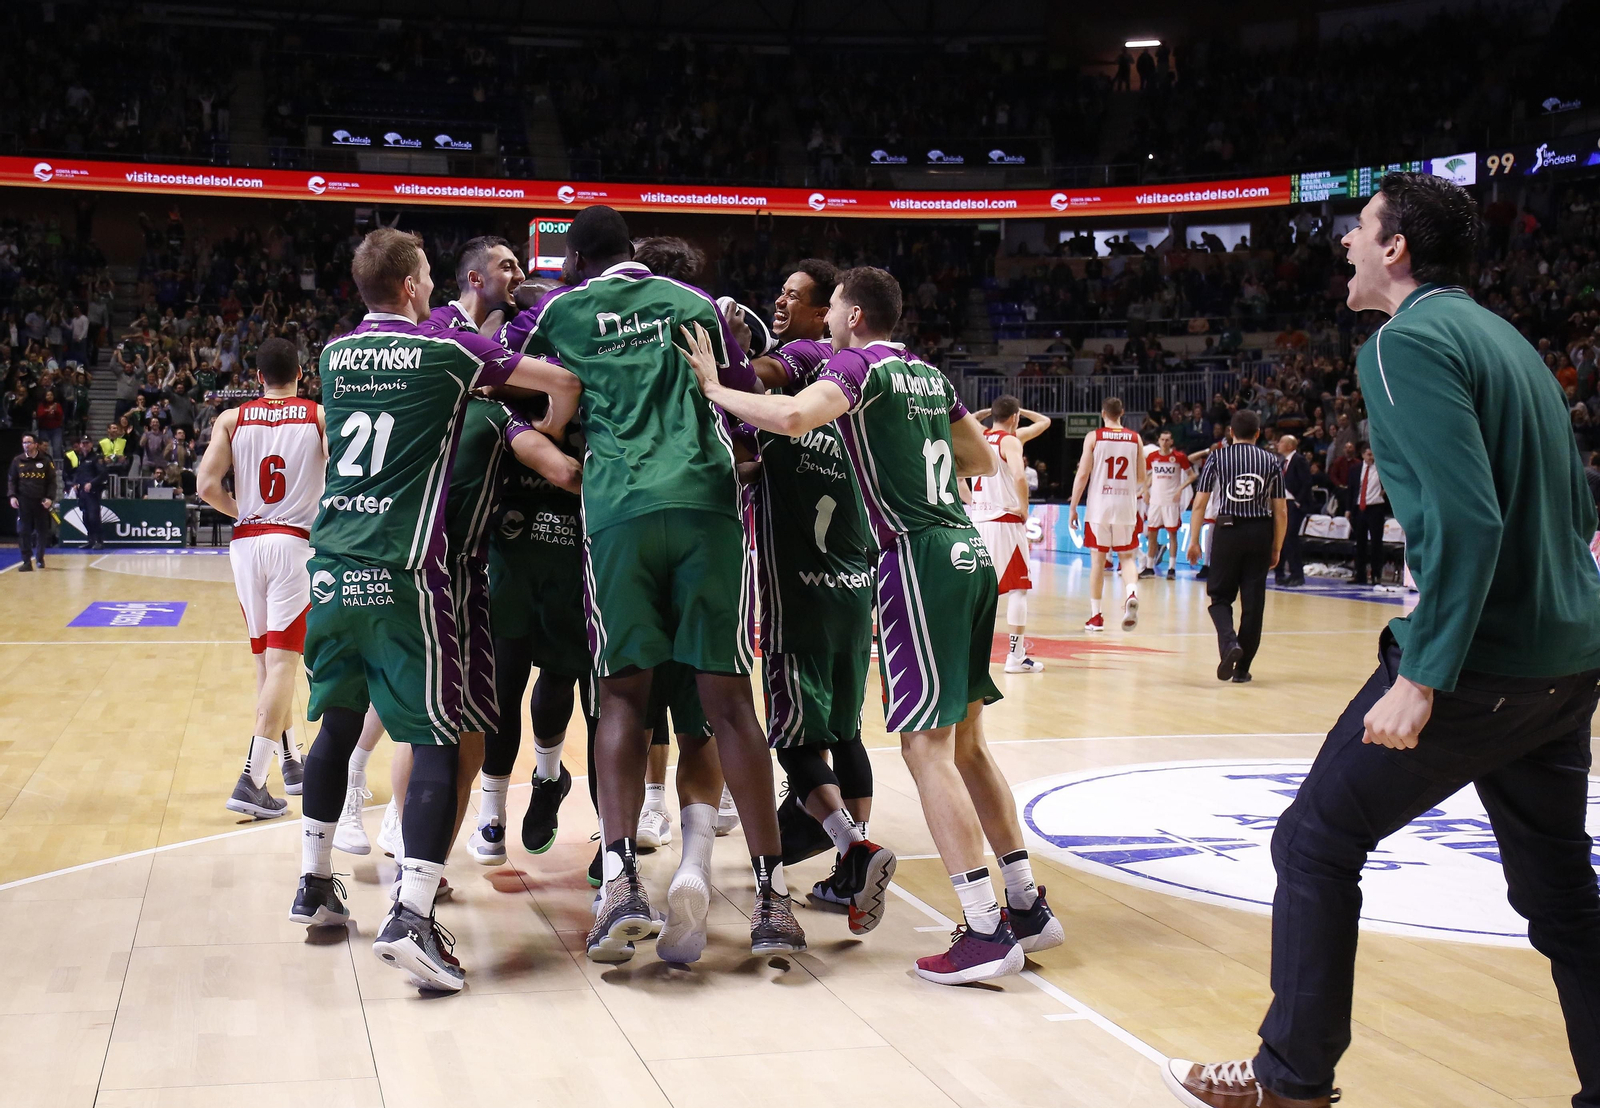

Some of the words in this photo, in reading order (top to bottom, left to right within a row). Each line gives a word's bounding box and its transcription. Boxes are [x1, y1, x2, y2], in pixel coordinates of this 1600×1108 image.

[1486, 152, 1514, 176] 99
[1544, 154, 1576, 166] endesa
[126, 171, 263, 188] visitacostadelsol.com
[1301, 170, 1330, 179] ROBERTS
[394, 184, 524, 198] visitacostadelsol.com
[1136, 186, 1270, 204] visitacostadelsol.com
[640, 192, 767, 206] visitacostadelsol.com
[890, 198, 1017, 210] visitacostadelsol.com
[598, 340, 626, 355] Ciudad
[328, 340, 422, 371] WACZYŃSKI
[244, 406, 307, 422] LUNDBERG
[1102, 431, 1133, 441] MURPHY
[337, 411, 395, 477] 21
[922, 438, 955, 505] 12
[1105, 456, 1129, 480] 12
[259, 455, 286, 504] 6
[1236, 480, 1255, 496] 53
[536, 512, 577, 526] COSTA
[814, 494, 837, 554] 1
[116, 521, 182, 540] Unicaja
[532, 522, 552, 533] DEL
[554, 525, 576, 536] SOL
[530, 531, 575, 546] MÁLAGA
[342, 568, 392, 583] COSTA
[798, 570, 871, 589] worten
[342, 585, 364, 596] DEL
[367, 583, 393, 594] SOL
[342, 595, 394, 607] MÁLAGA
